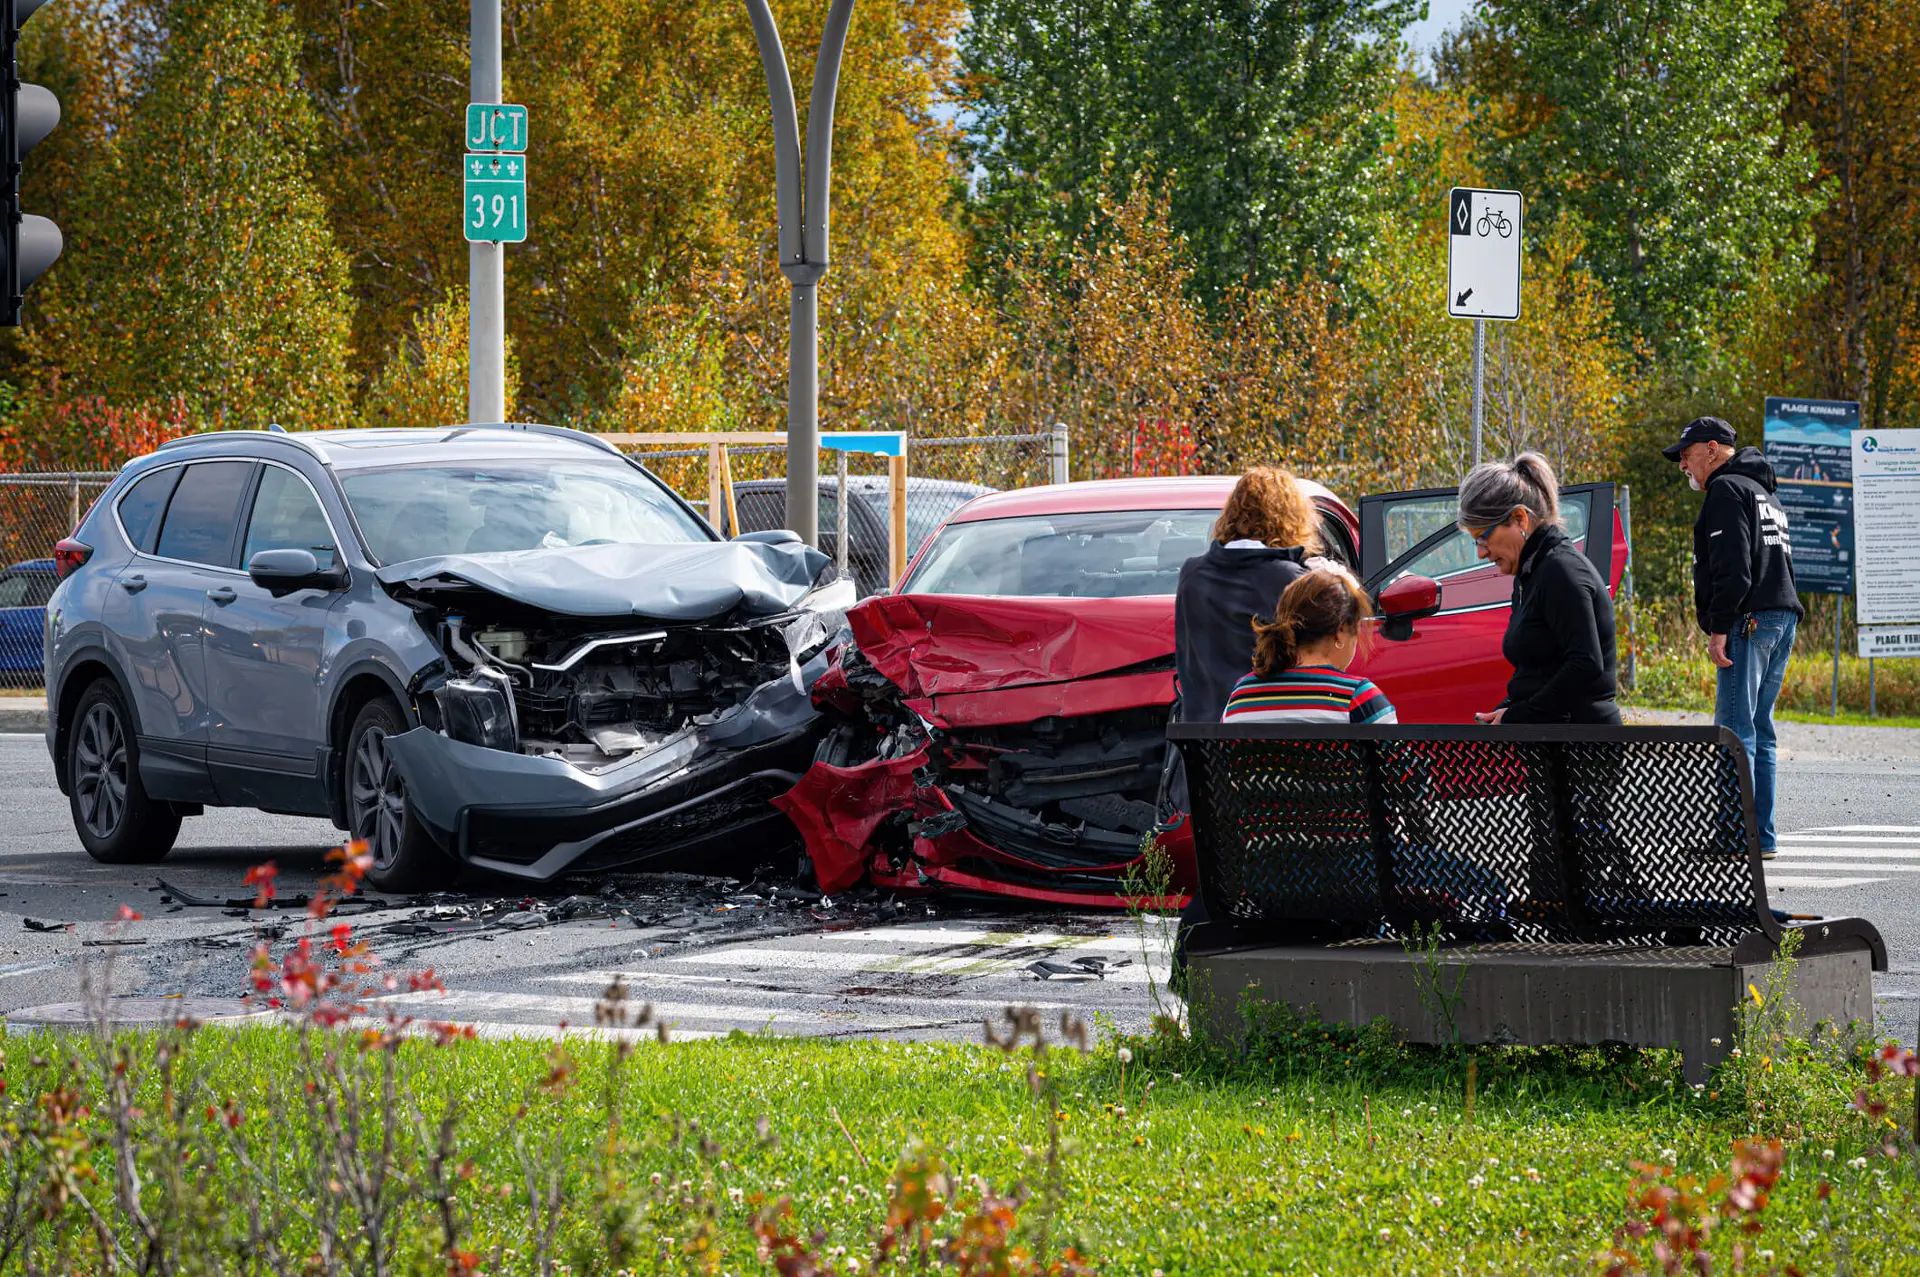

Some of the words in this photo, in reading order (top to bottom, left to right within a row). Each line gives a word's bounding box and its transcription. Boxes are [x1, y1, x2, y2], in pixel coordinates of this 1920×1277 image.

[472, 112, 523, 145] JCT
[472, 195, 517, 228] 391
[1781, 403, 1808, 413] PLAGE
[1810, 405, 1846, 415] KIWANIS
[1875, 635, 1901, 645] PLAGE
[1904, 634, 1920, 644] FER
